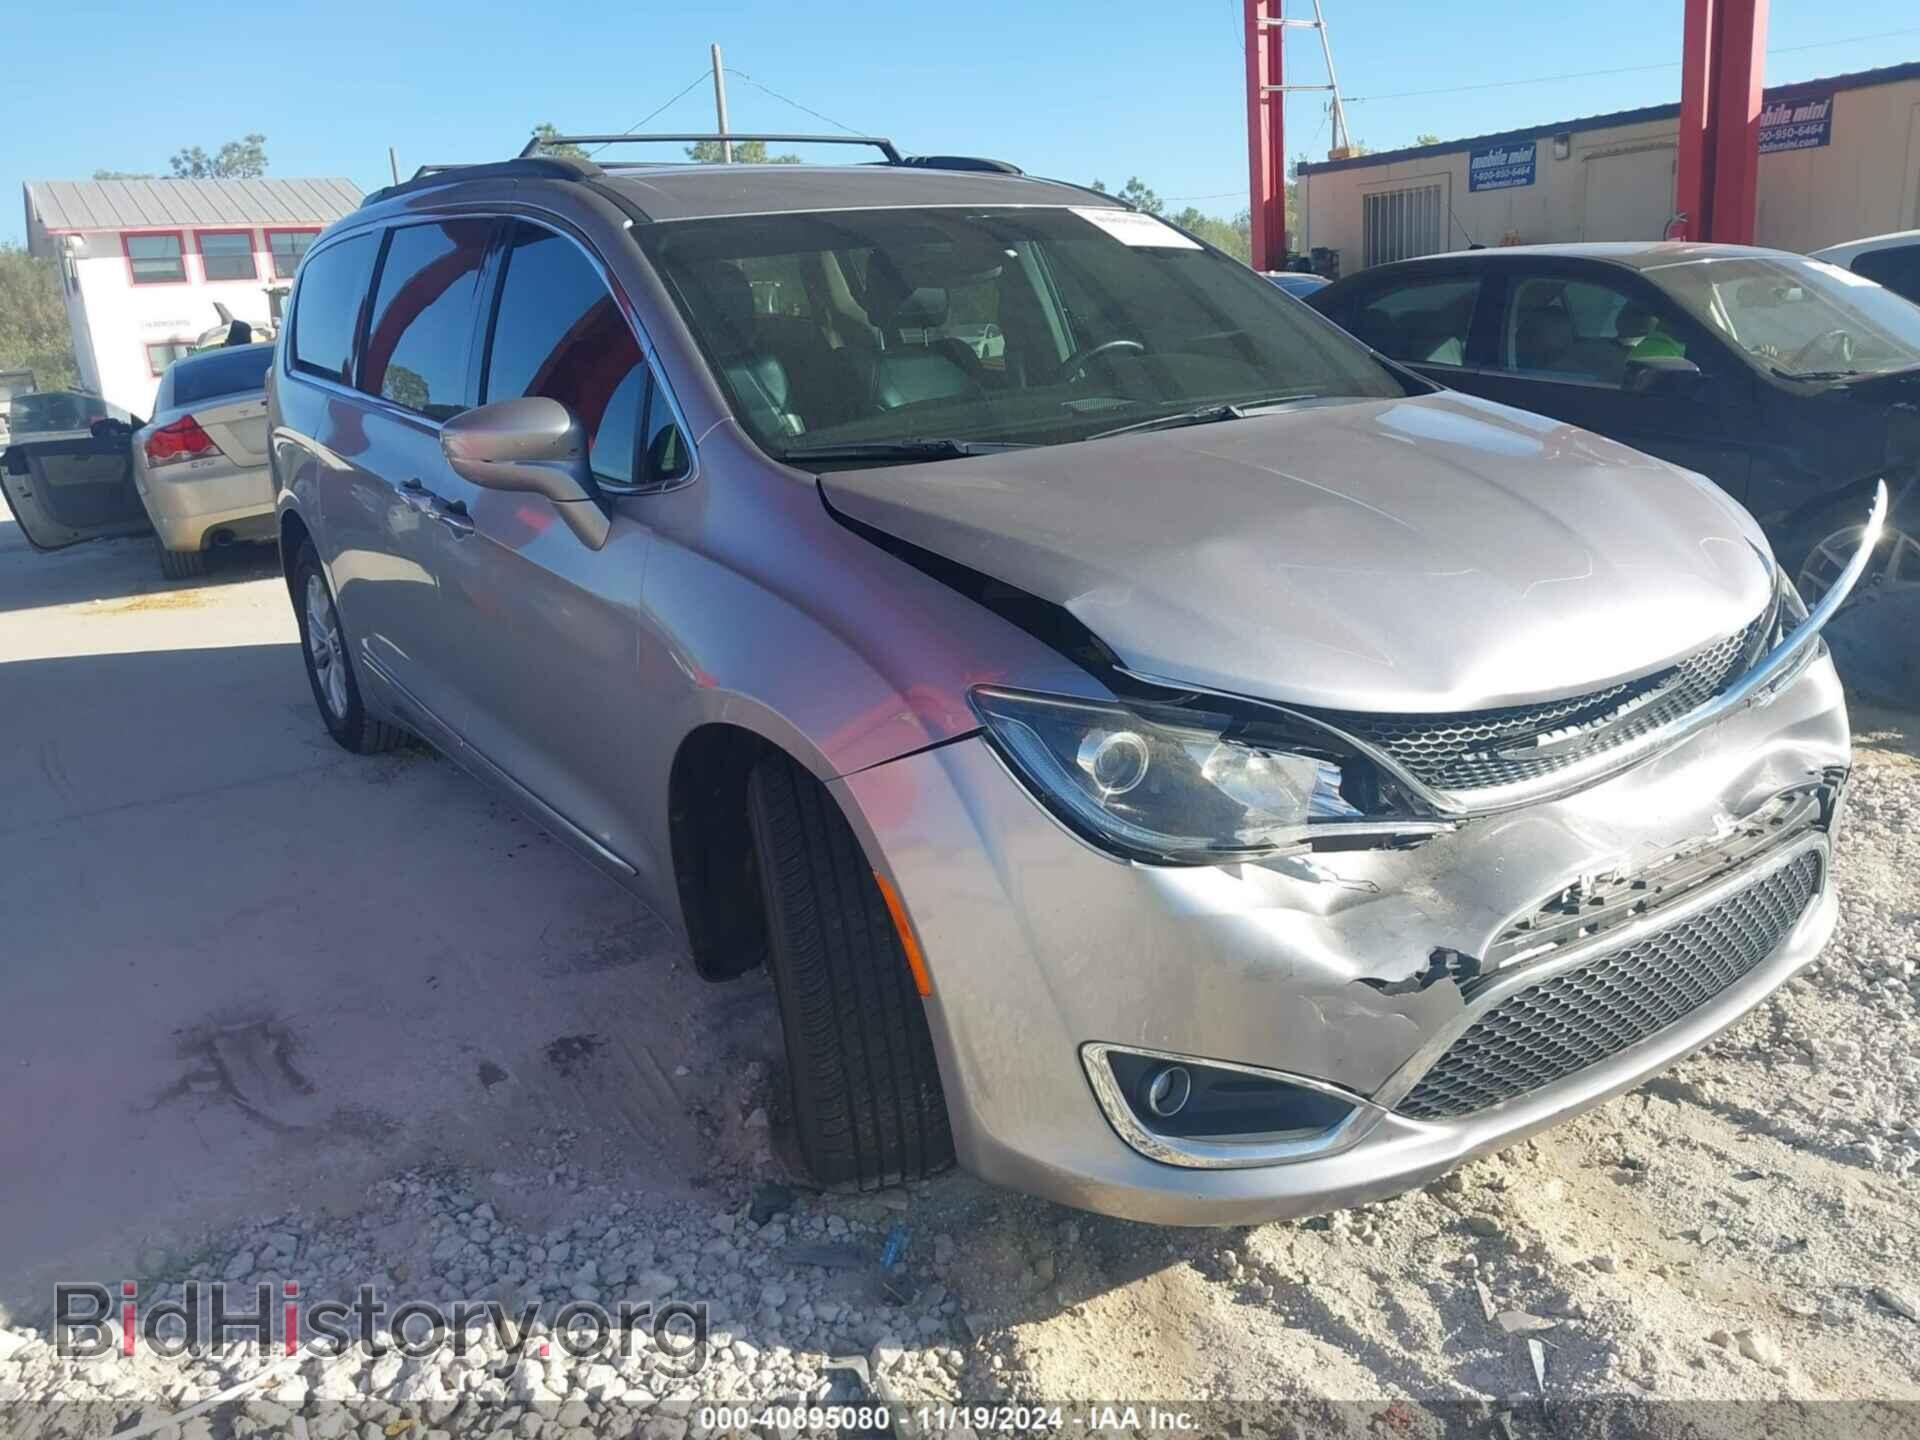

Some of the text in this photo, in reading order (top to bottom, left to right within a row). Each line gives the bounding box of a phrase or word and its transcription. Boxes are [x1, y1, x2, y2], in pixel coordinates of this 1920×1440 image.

[1792, 99, 1830, 123] mini
[1472, 145, 1535, 169] mobile mini
